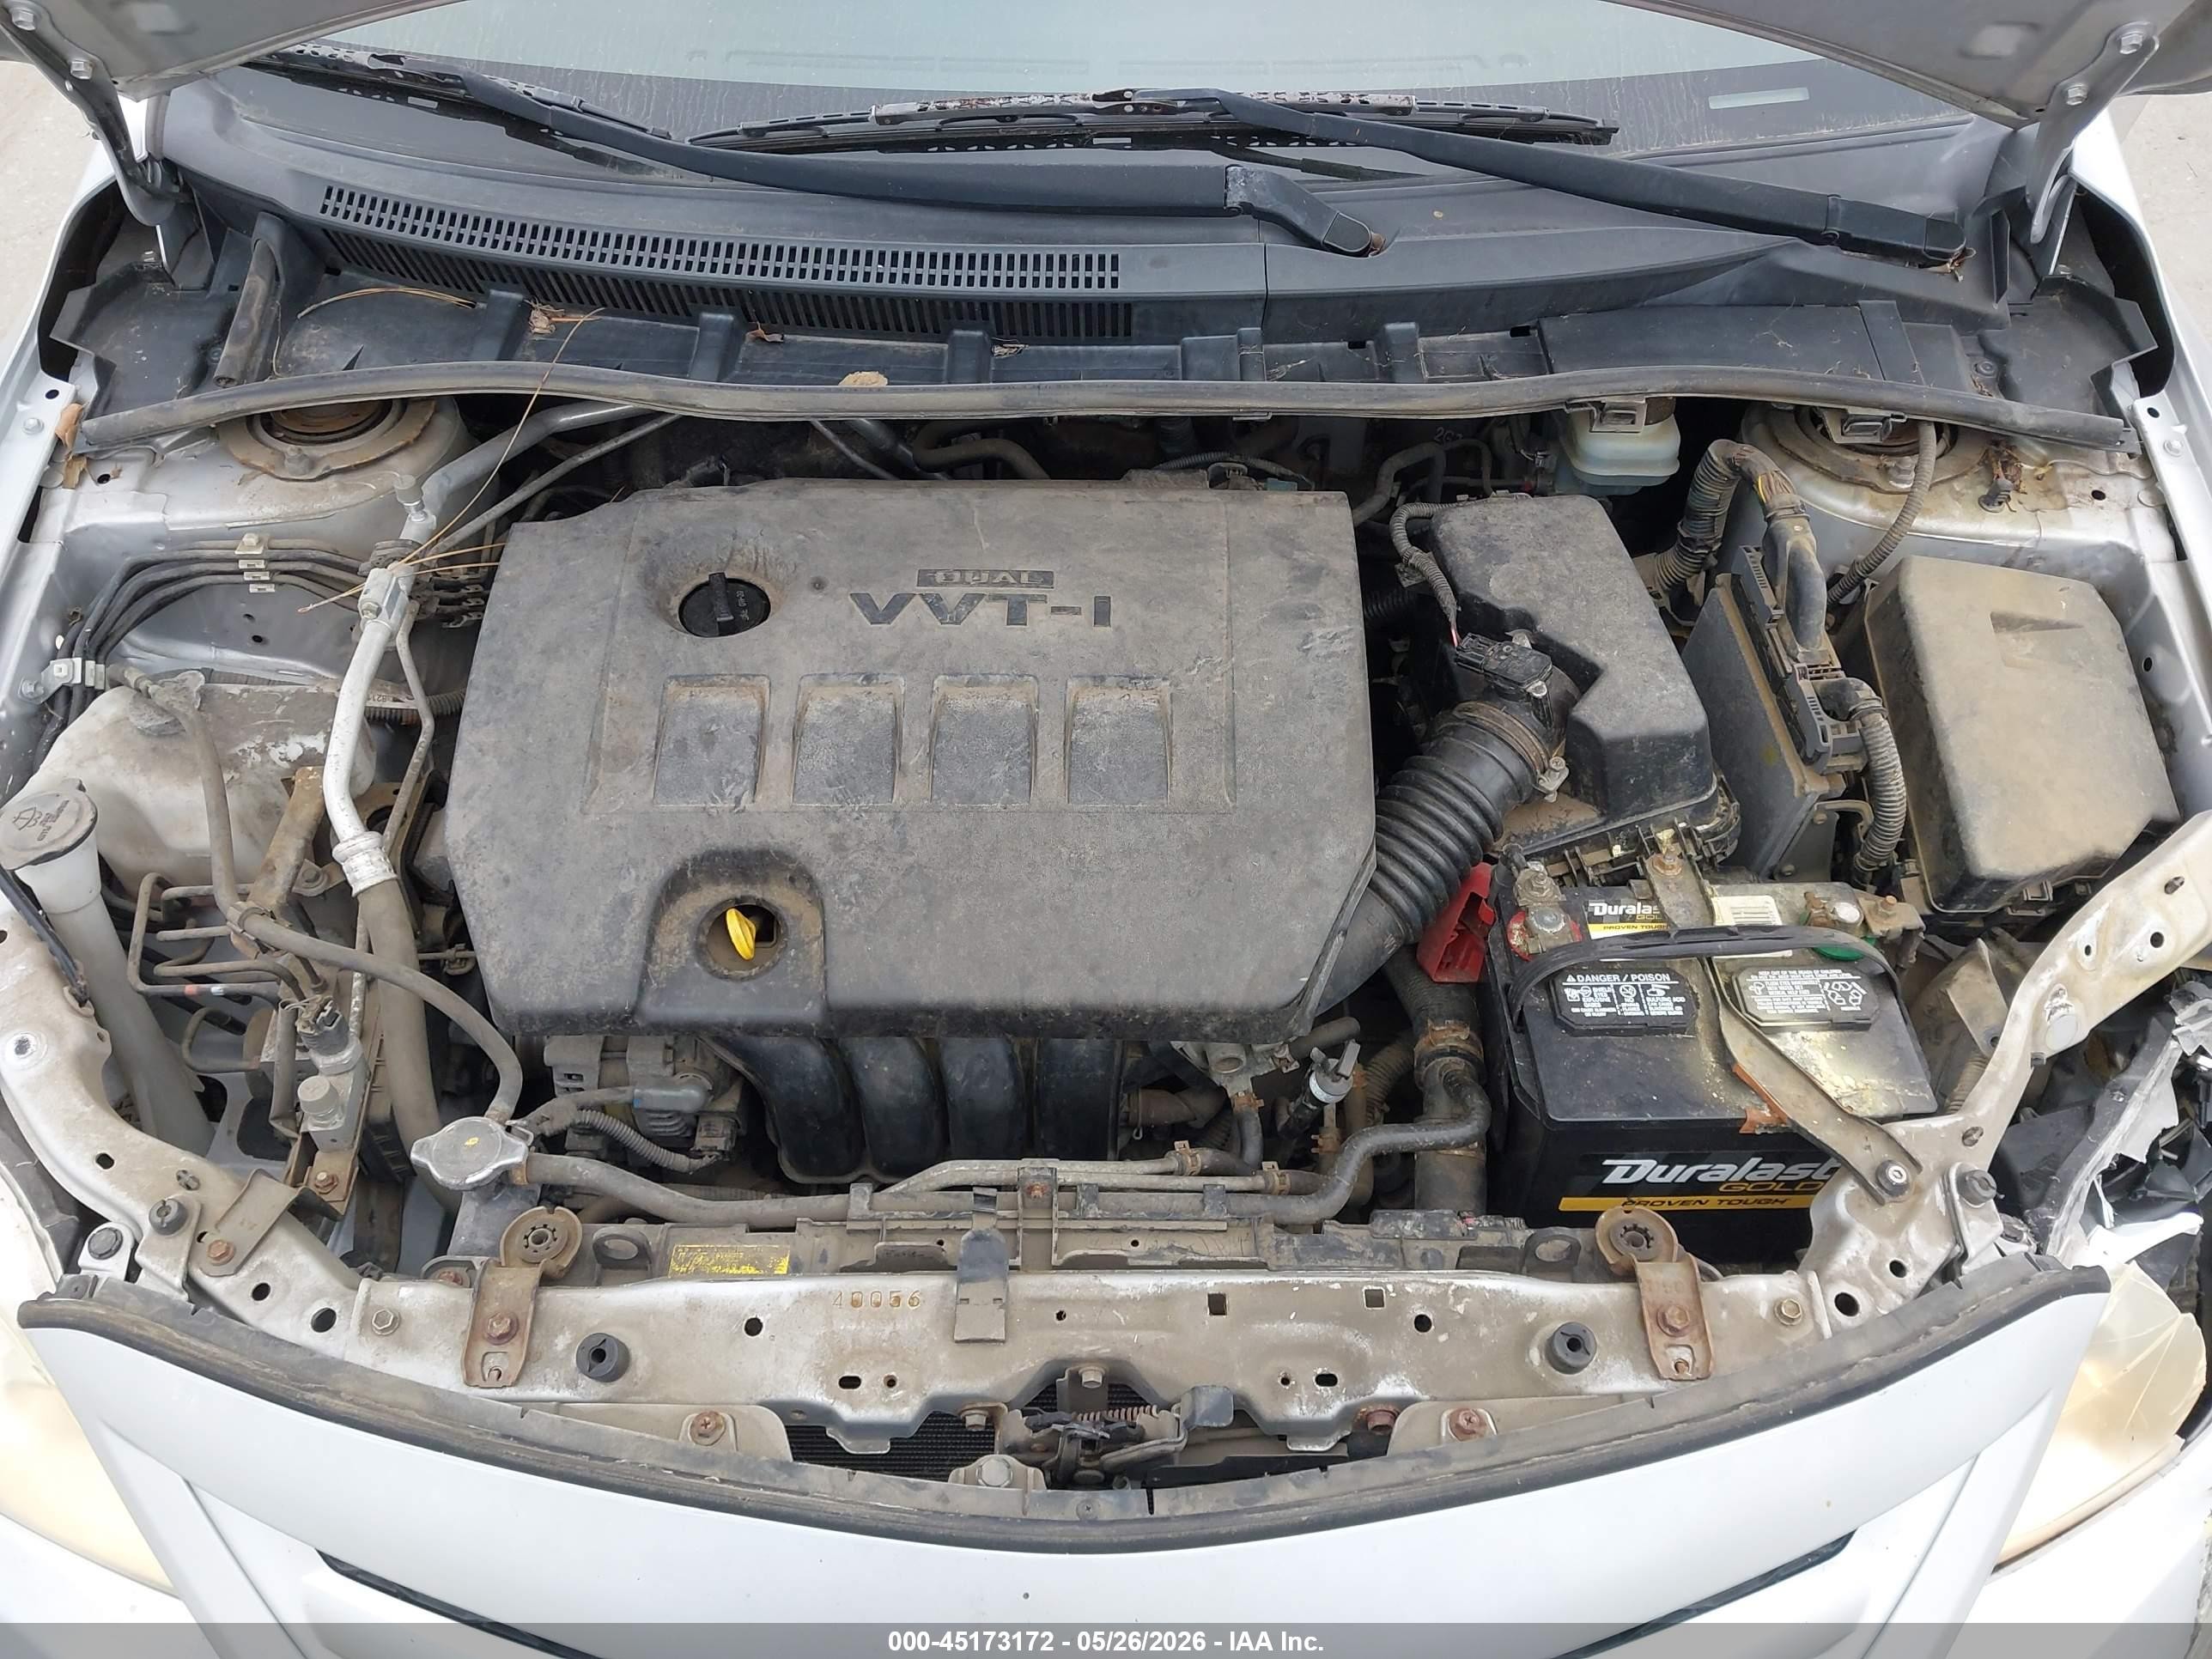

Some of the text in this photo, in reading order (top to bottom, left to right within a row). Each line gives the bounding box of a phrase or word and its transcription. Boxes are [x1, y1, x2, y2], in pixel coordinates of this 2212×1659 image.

[1577, 974, 1620, 982] DANGER
[1631, 973, 1671, 982] POISON
[1601, 1157, 1842, 1184] Duralast
[1717, 1181, 1825, 1193] GOLD
[1621, 1197, 1791, 1207] PROVEN TOUGH
[832, 1289, 921, 1309] 40056
